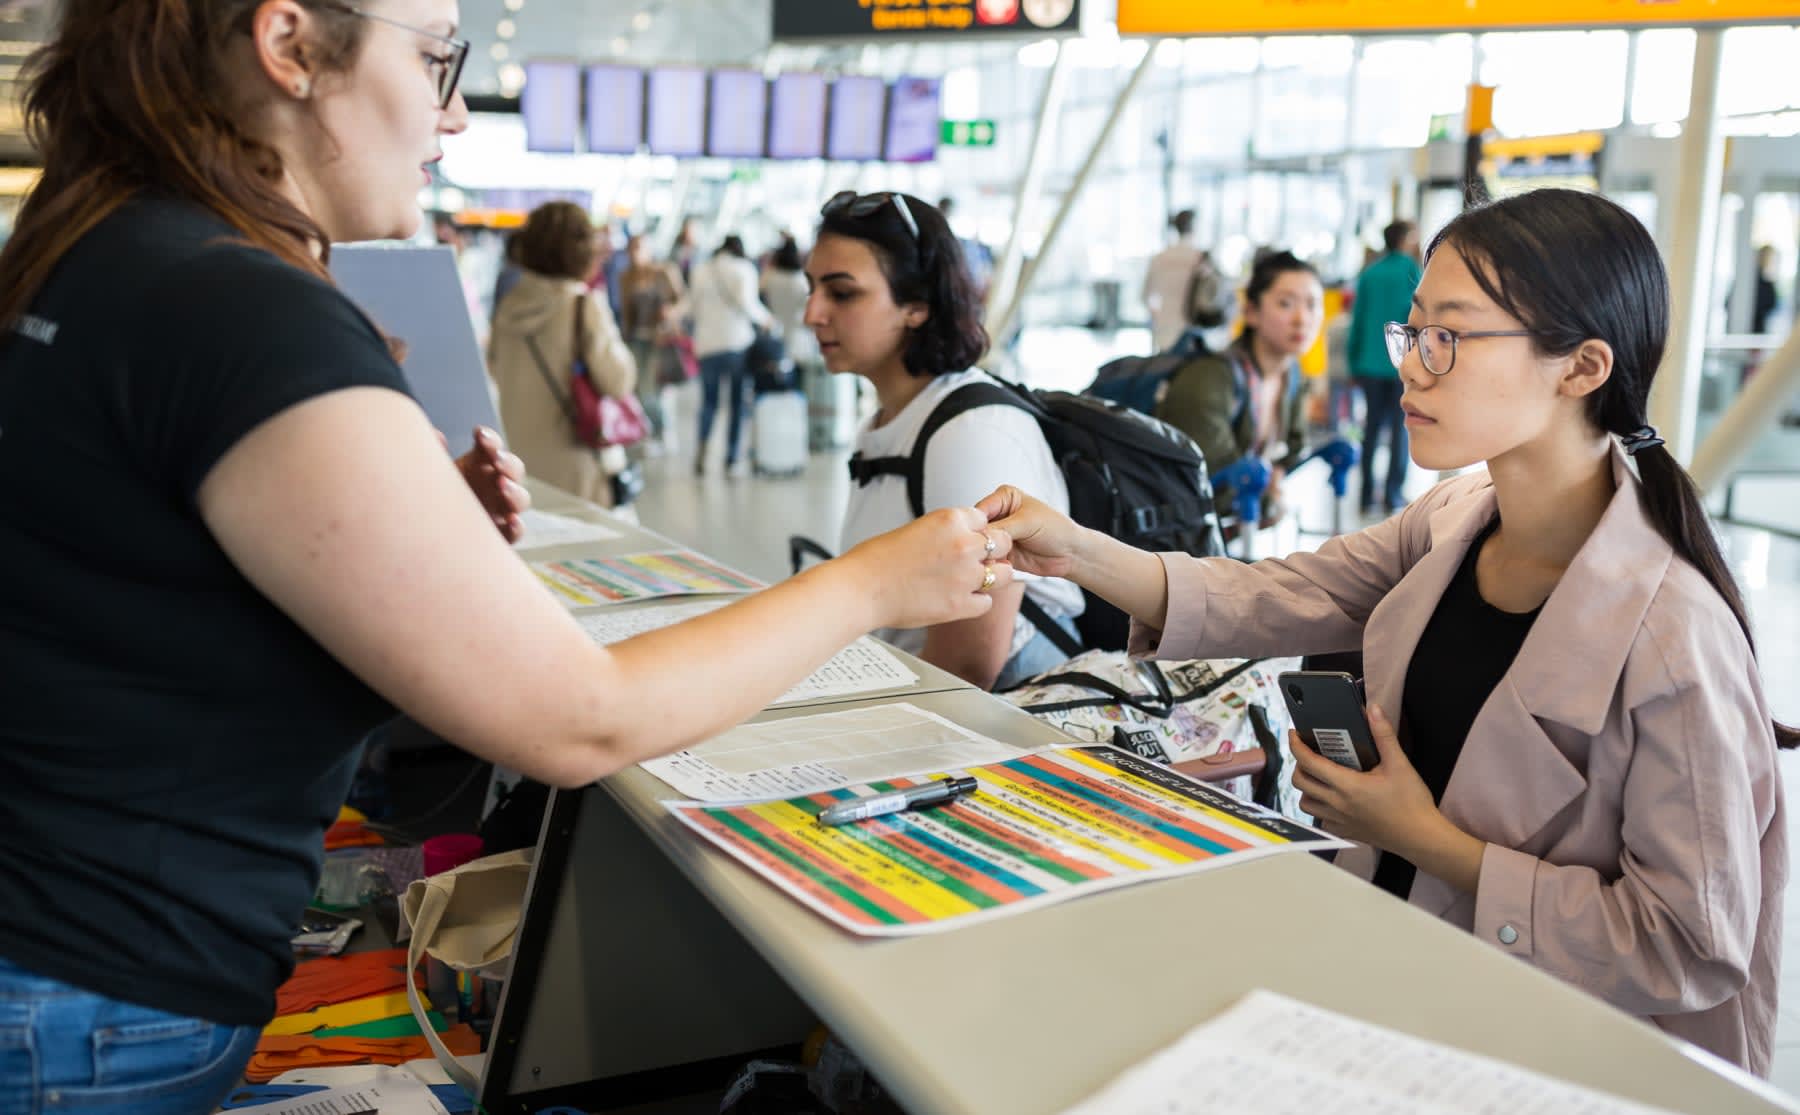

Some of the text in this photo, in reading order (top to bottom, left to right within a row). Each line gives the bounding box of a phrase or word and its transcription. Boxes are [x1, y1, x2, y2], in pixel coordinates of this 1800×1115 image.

[1137, 742, 1161, 757] OUT
[1099, 751, 1171, 788] LUGGAGE
[1171, 781, 1238, 810] LABELS
